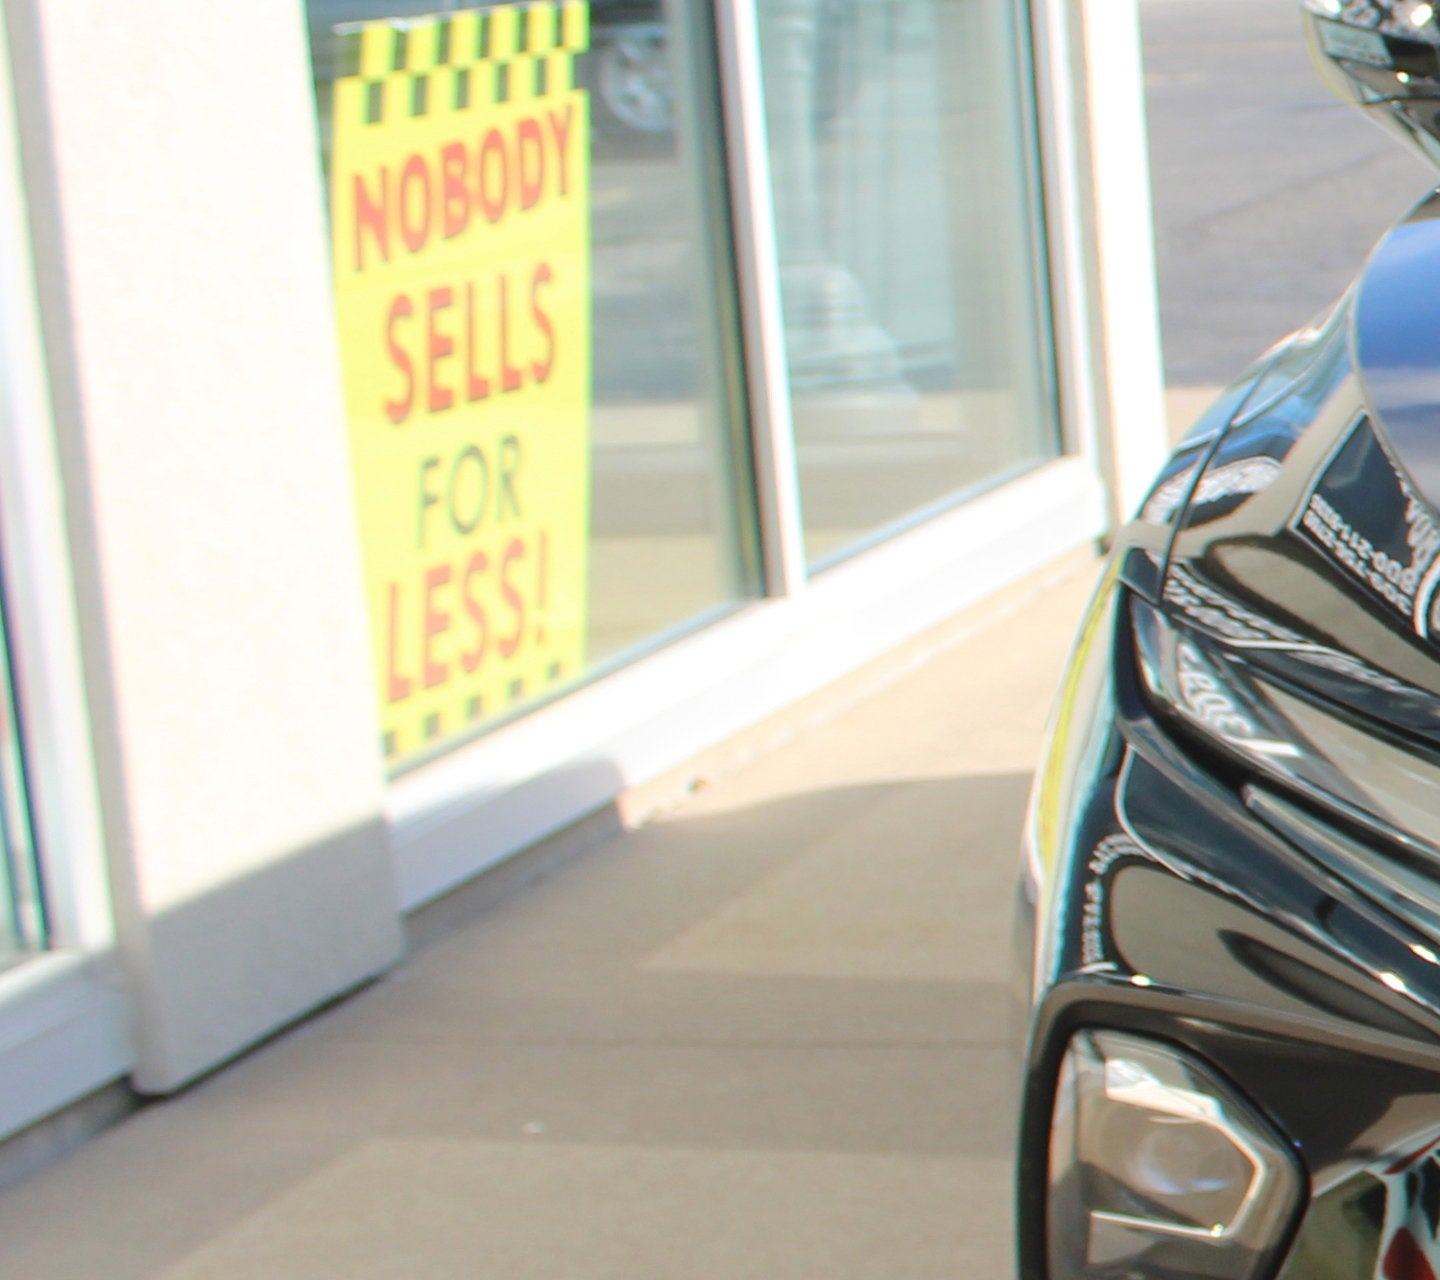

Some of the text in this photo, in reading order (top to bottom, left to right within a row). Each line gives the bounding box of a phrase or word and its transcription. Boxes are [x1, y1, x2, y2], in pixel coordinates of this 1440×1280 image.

[352, 103, 576, 273] NOBODY
[384, 261, 557, 425] SELLS
[418, 433, 522, 549] FOR
[385, 531, 550, 704] LESS!
